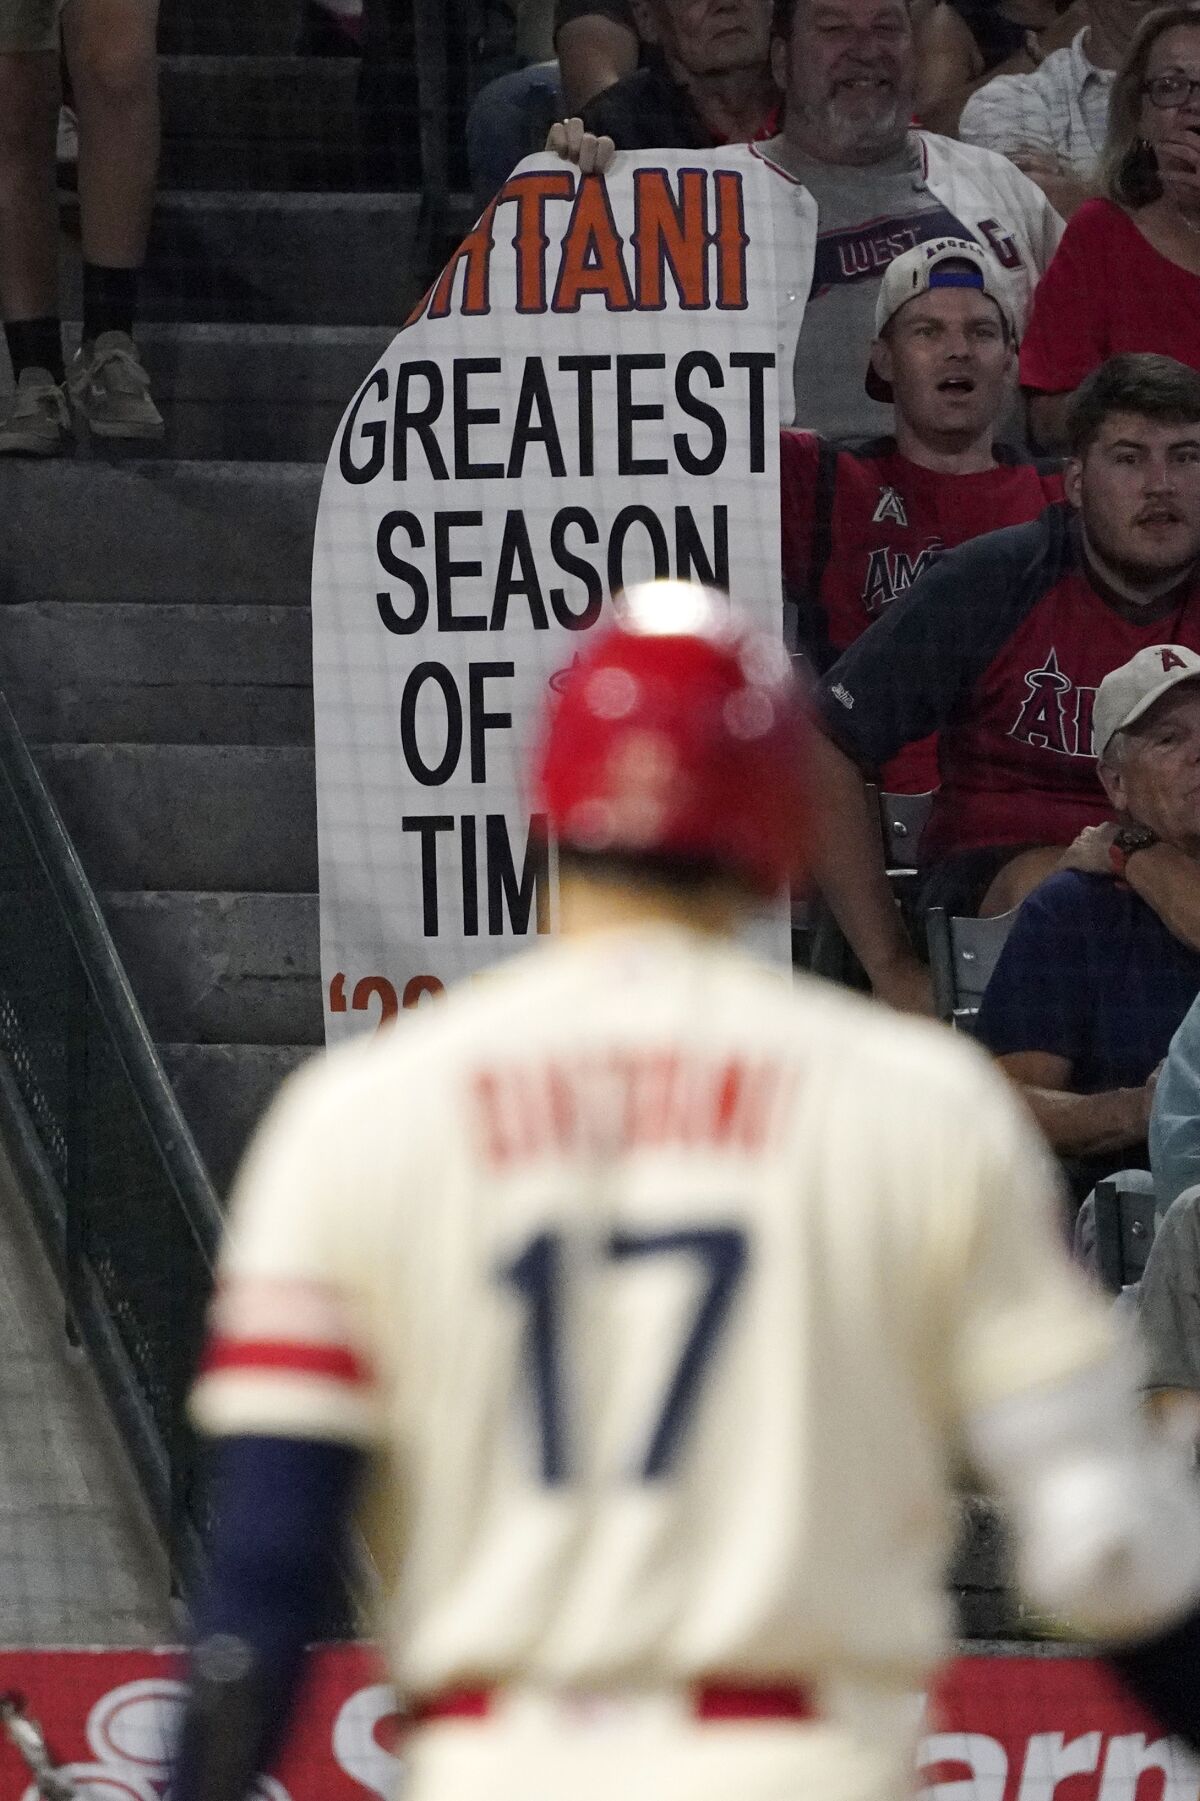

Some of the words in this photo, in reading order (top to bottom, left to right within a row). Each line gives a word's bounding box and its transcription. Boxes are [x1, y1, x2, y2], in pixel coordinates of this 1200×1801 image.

[402, 167, 750, 333] HTANI
[339, 350, 776, 485] GREATEST
[871, 486, 908, 526] A
[376, 505, 729, 635] SEASON
[1155, 647, 1189, 672] A
[400, 661, 515, 786] OF
[402, 813, 551, 937] TIM
[492, 1225, 750, 1484] 17
